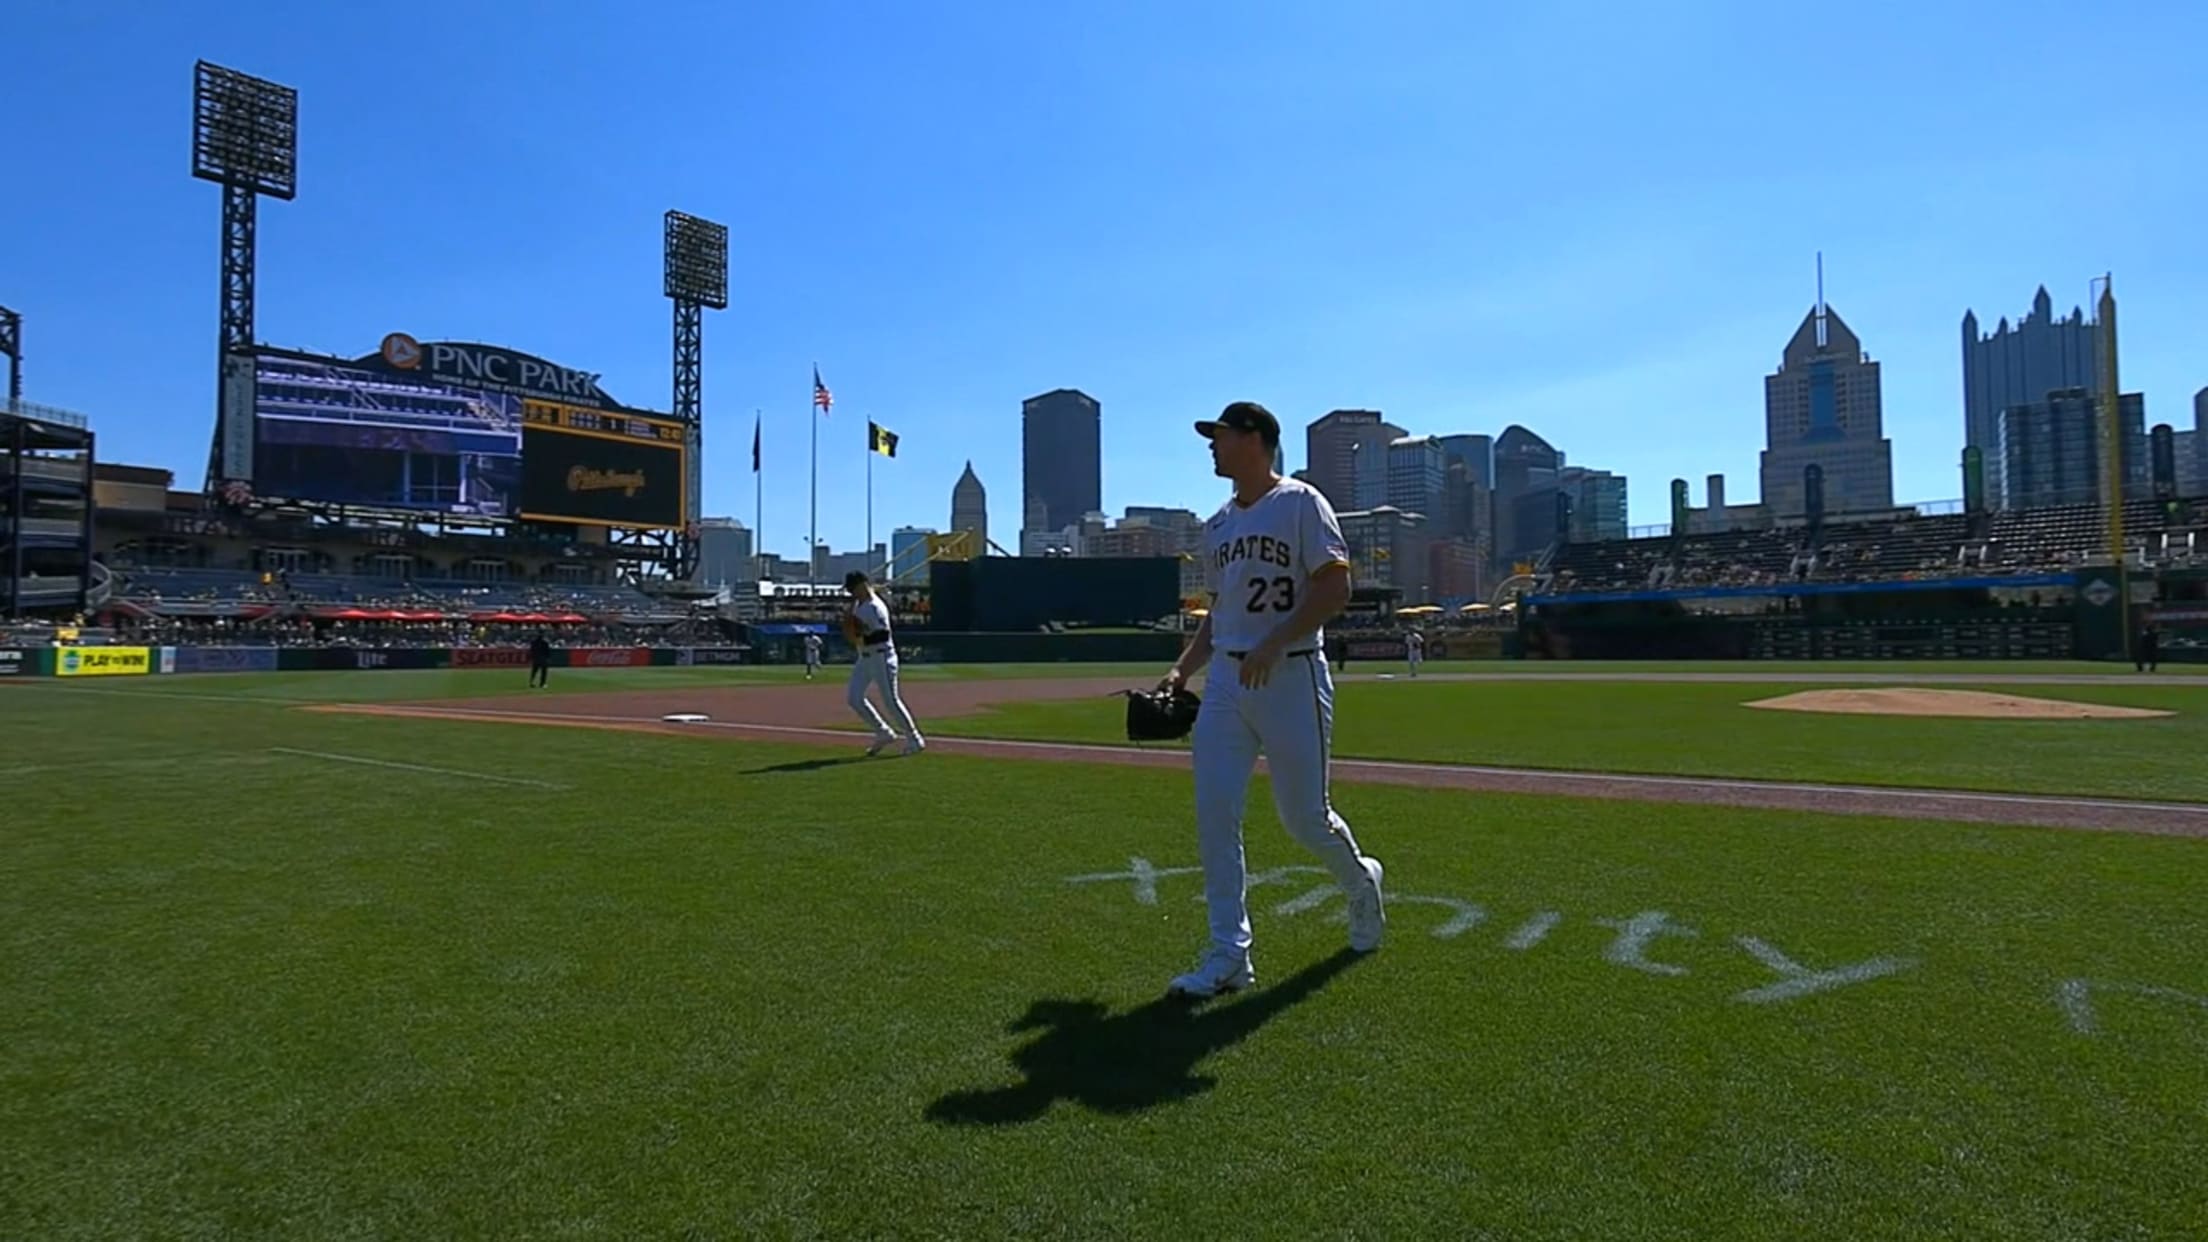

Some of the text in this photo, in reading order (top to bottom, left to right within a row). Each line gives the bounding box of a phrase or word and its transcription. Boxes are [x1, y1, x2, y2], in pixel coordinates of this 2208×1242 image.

[431, 345, 603, 398] PNC PARK
[1246, 576, 1296, 614] 23
[84, 654, 110, 667] PLAY
